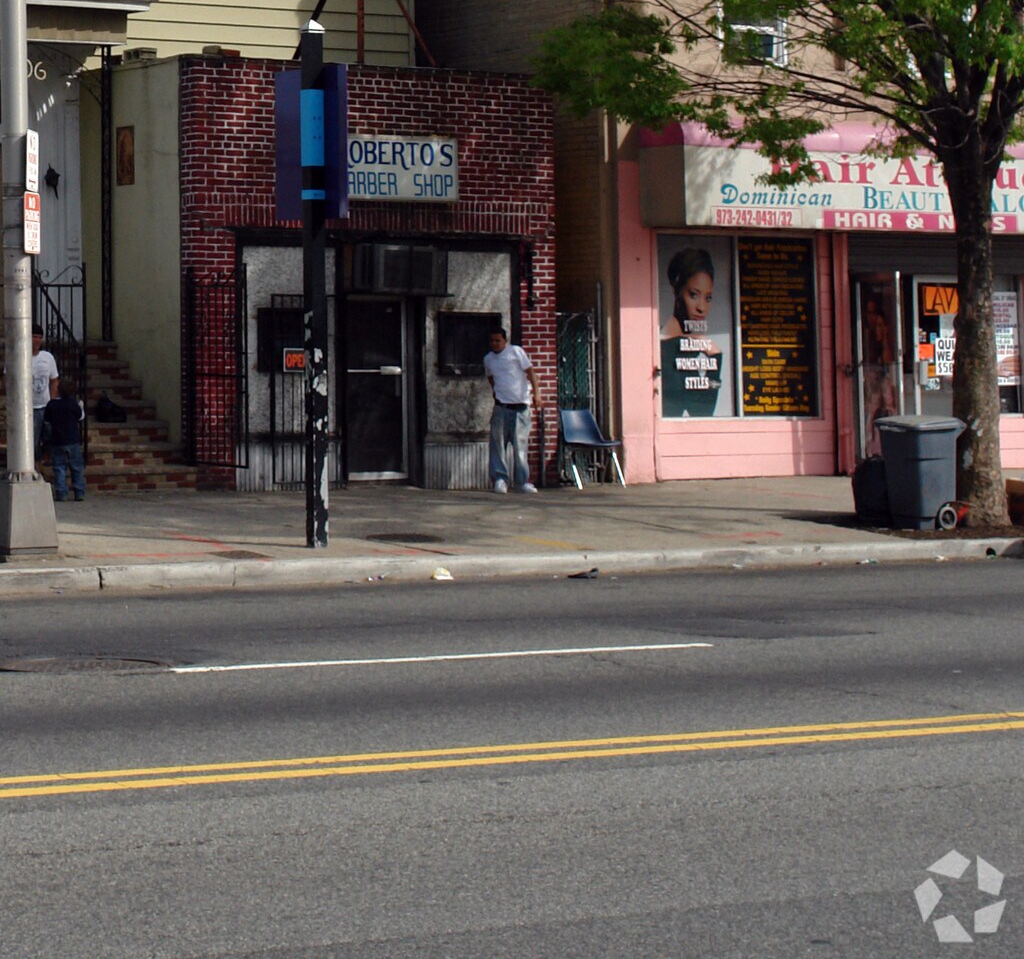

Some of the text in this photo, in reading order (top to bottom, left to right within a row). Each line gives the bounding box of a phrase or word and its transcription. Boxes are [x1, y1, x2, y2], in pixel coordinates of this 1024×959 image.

[347, 140, 453, 170] OBERTO'S
[347, 171, 453, 197] ARBER SHOP
[720, 183, 833, 206] Dominican
[863, 186, 945, 211] BEAUT
[716, 208, 793, 227] 973-242-0431/32
[834, 211, 893, 229] HAIR
[905, 213, 925, 230] &
[684, 320, 708, 332] TWISTS
[679, 338, 712, 351] BRAIDING
[937, 339, 955, 350] QUI
[286, 353, 304, 368] OPE
[936, 351, 954, 361] WE
[675, 357, 718, 370] WOMEN HAIR
[685, 377, 709, 389] STYLES
